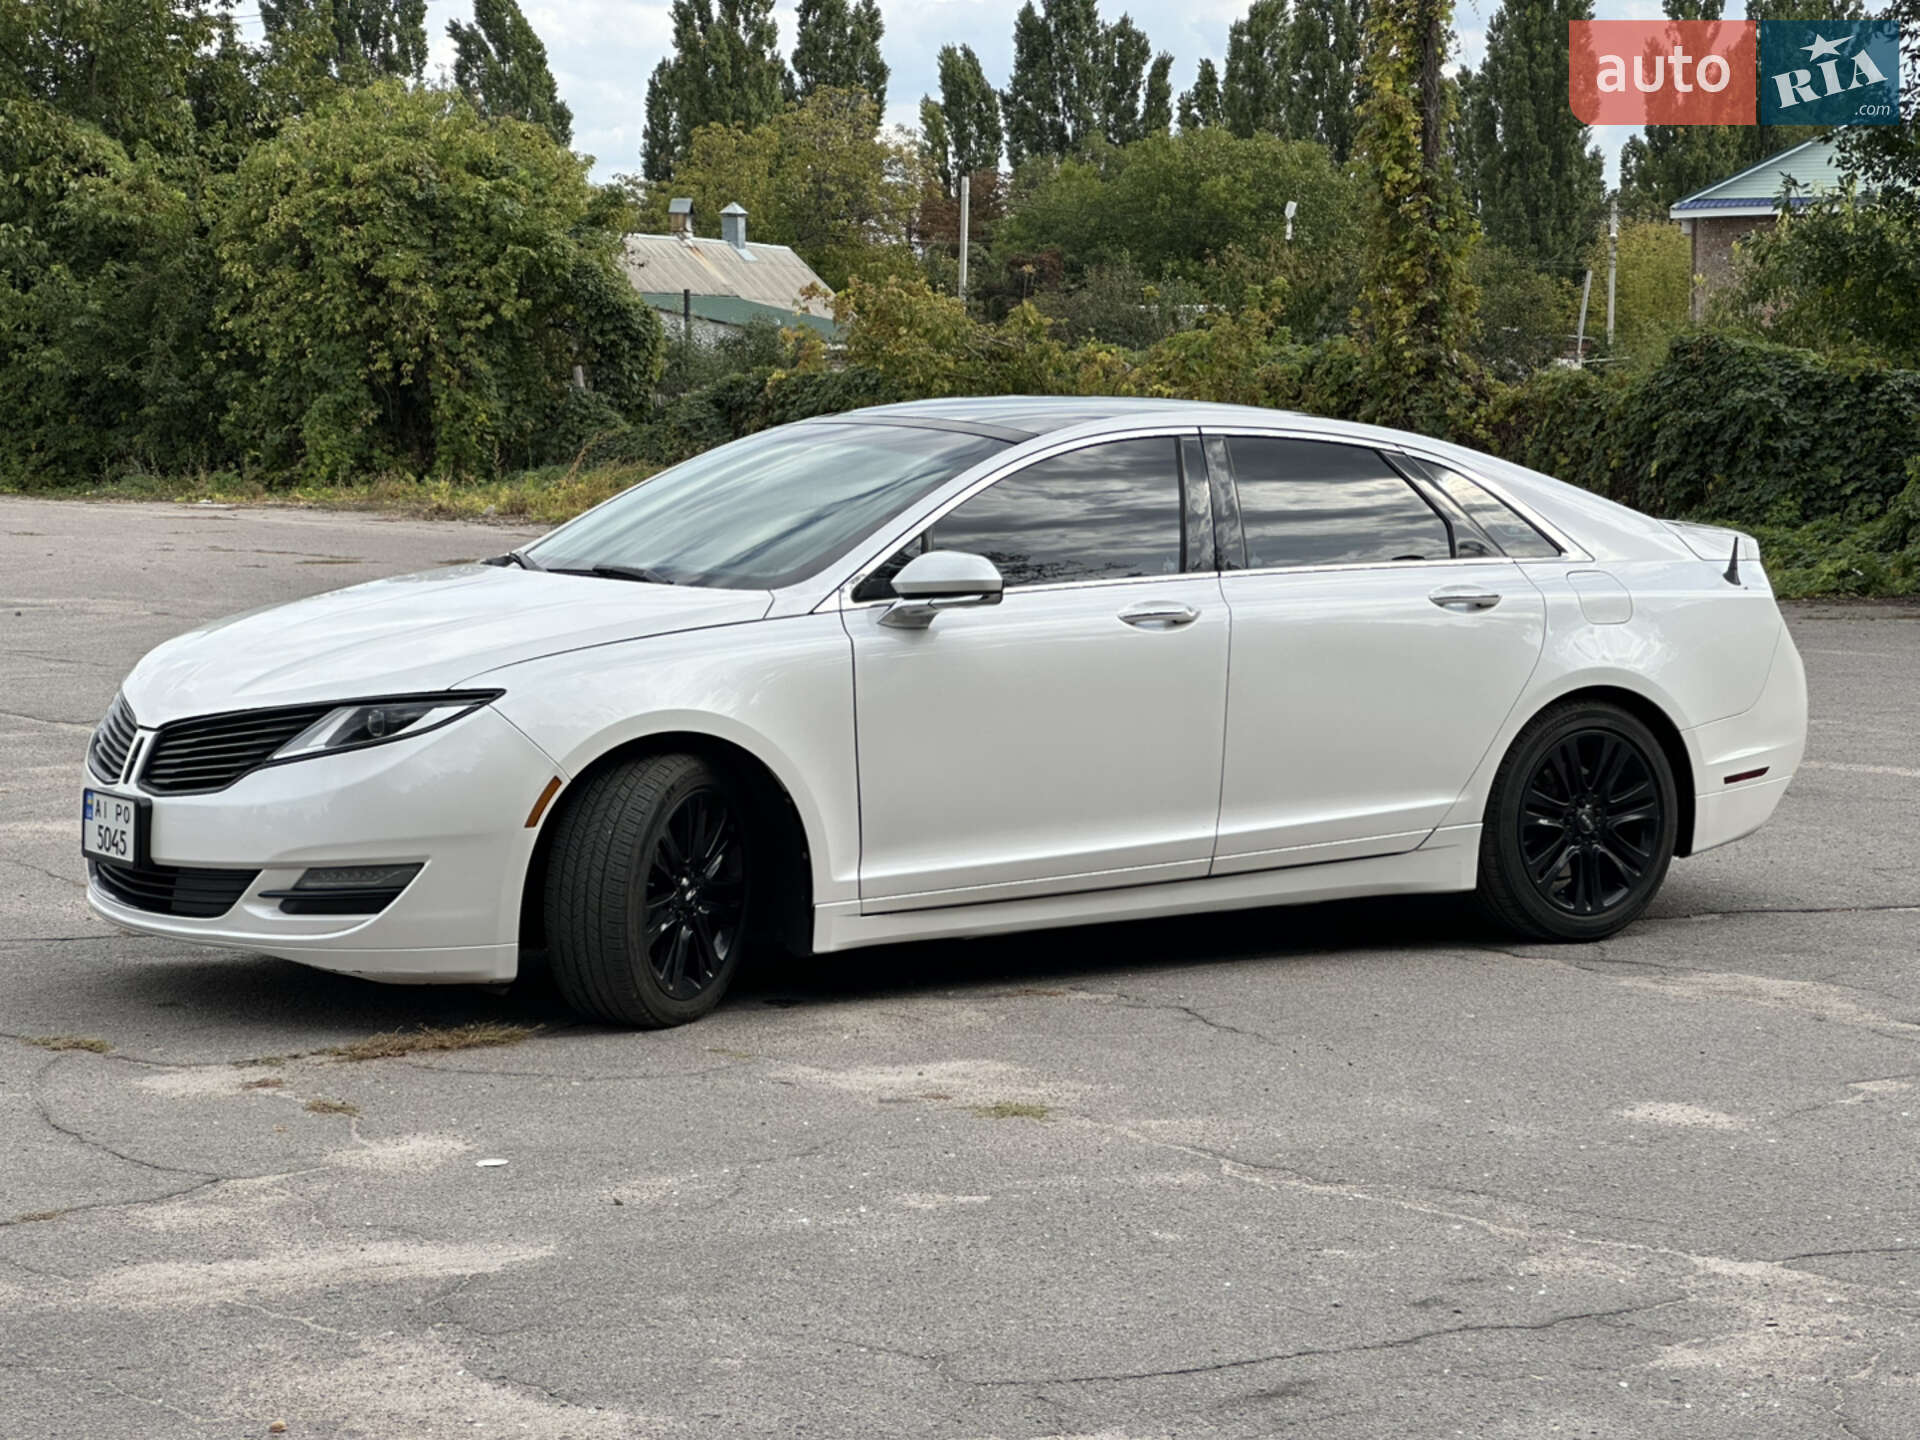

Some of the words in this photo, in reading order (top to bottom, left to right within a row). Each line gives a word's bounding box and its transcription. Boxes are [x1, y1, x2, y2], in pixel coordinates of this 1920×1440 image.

[95, 799, 107, 819] AI
[115, 803, 130, 824] PO
[96, 824, 127, 856] 5045
